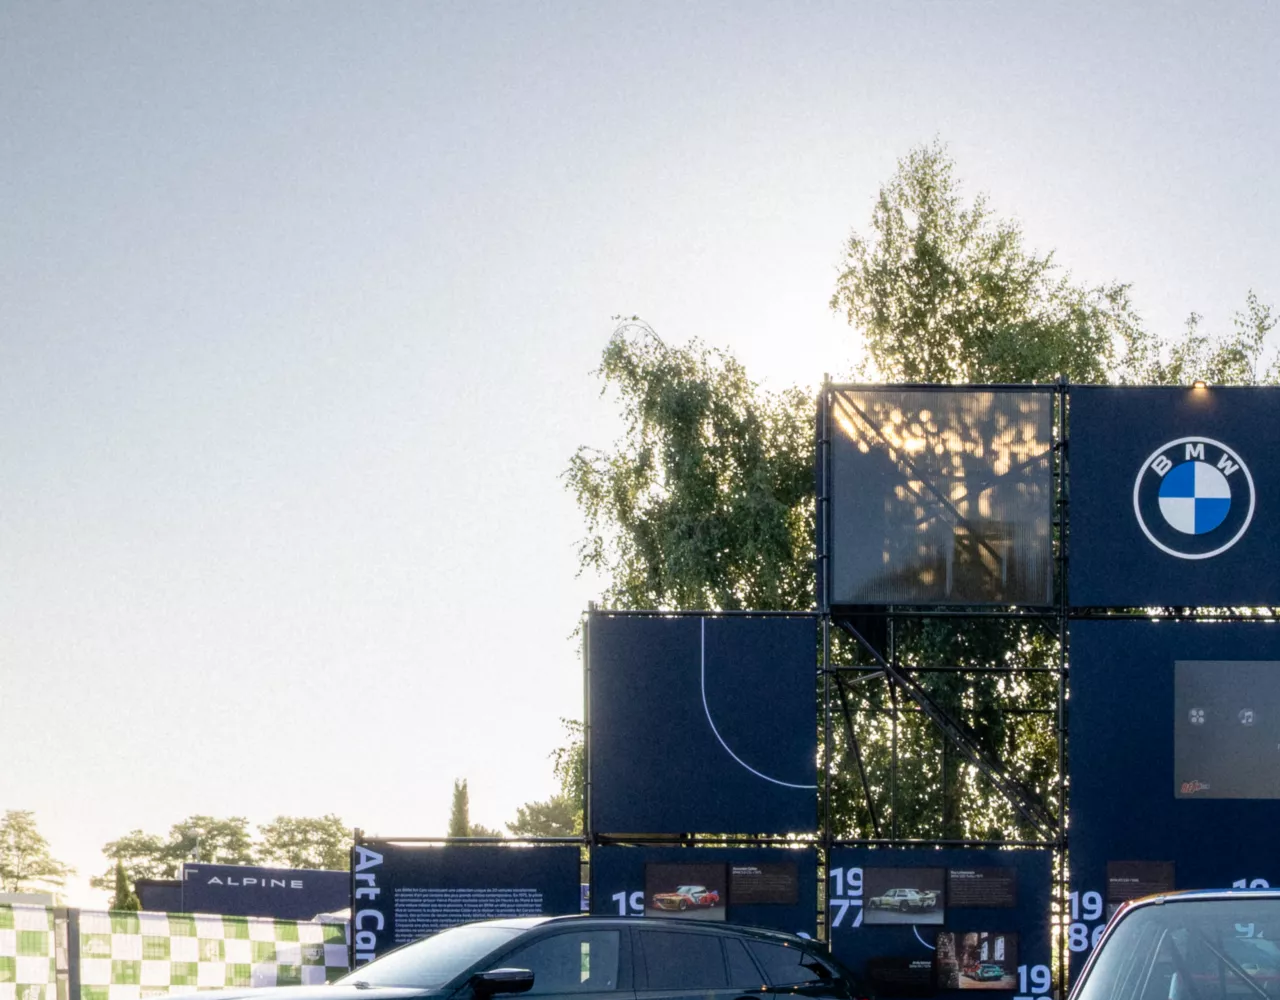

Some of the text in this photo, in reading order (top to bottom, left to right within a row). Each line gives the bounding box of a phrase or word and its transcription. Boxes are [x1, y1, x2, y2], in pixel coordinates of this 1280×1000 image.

[1151, 444, 1239, 477] BMW
[207, 876, 304, 889] ALPINE
[356, 845, 383, 900] Art
[830, 867, 863, 896] 19
[830, 899, 863, 928] 77
[1068, 891, 1103, 920] 19
[1018, 965, 1051, 994] 19
